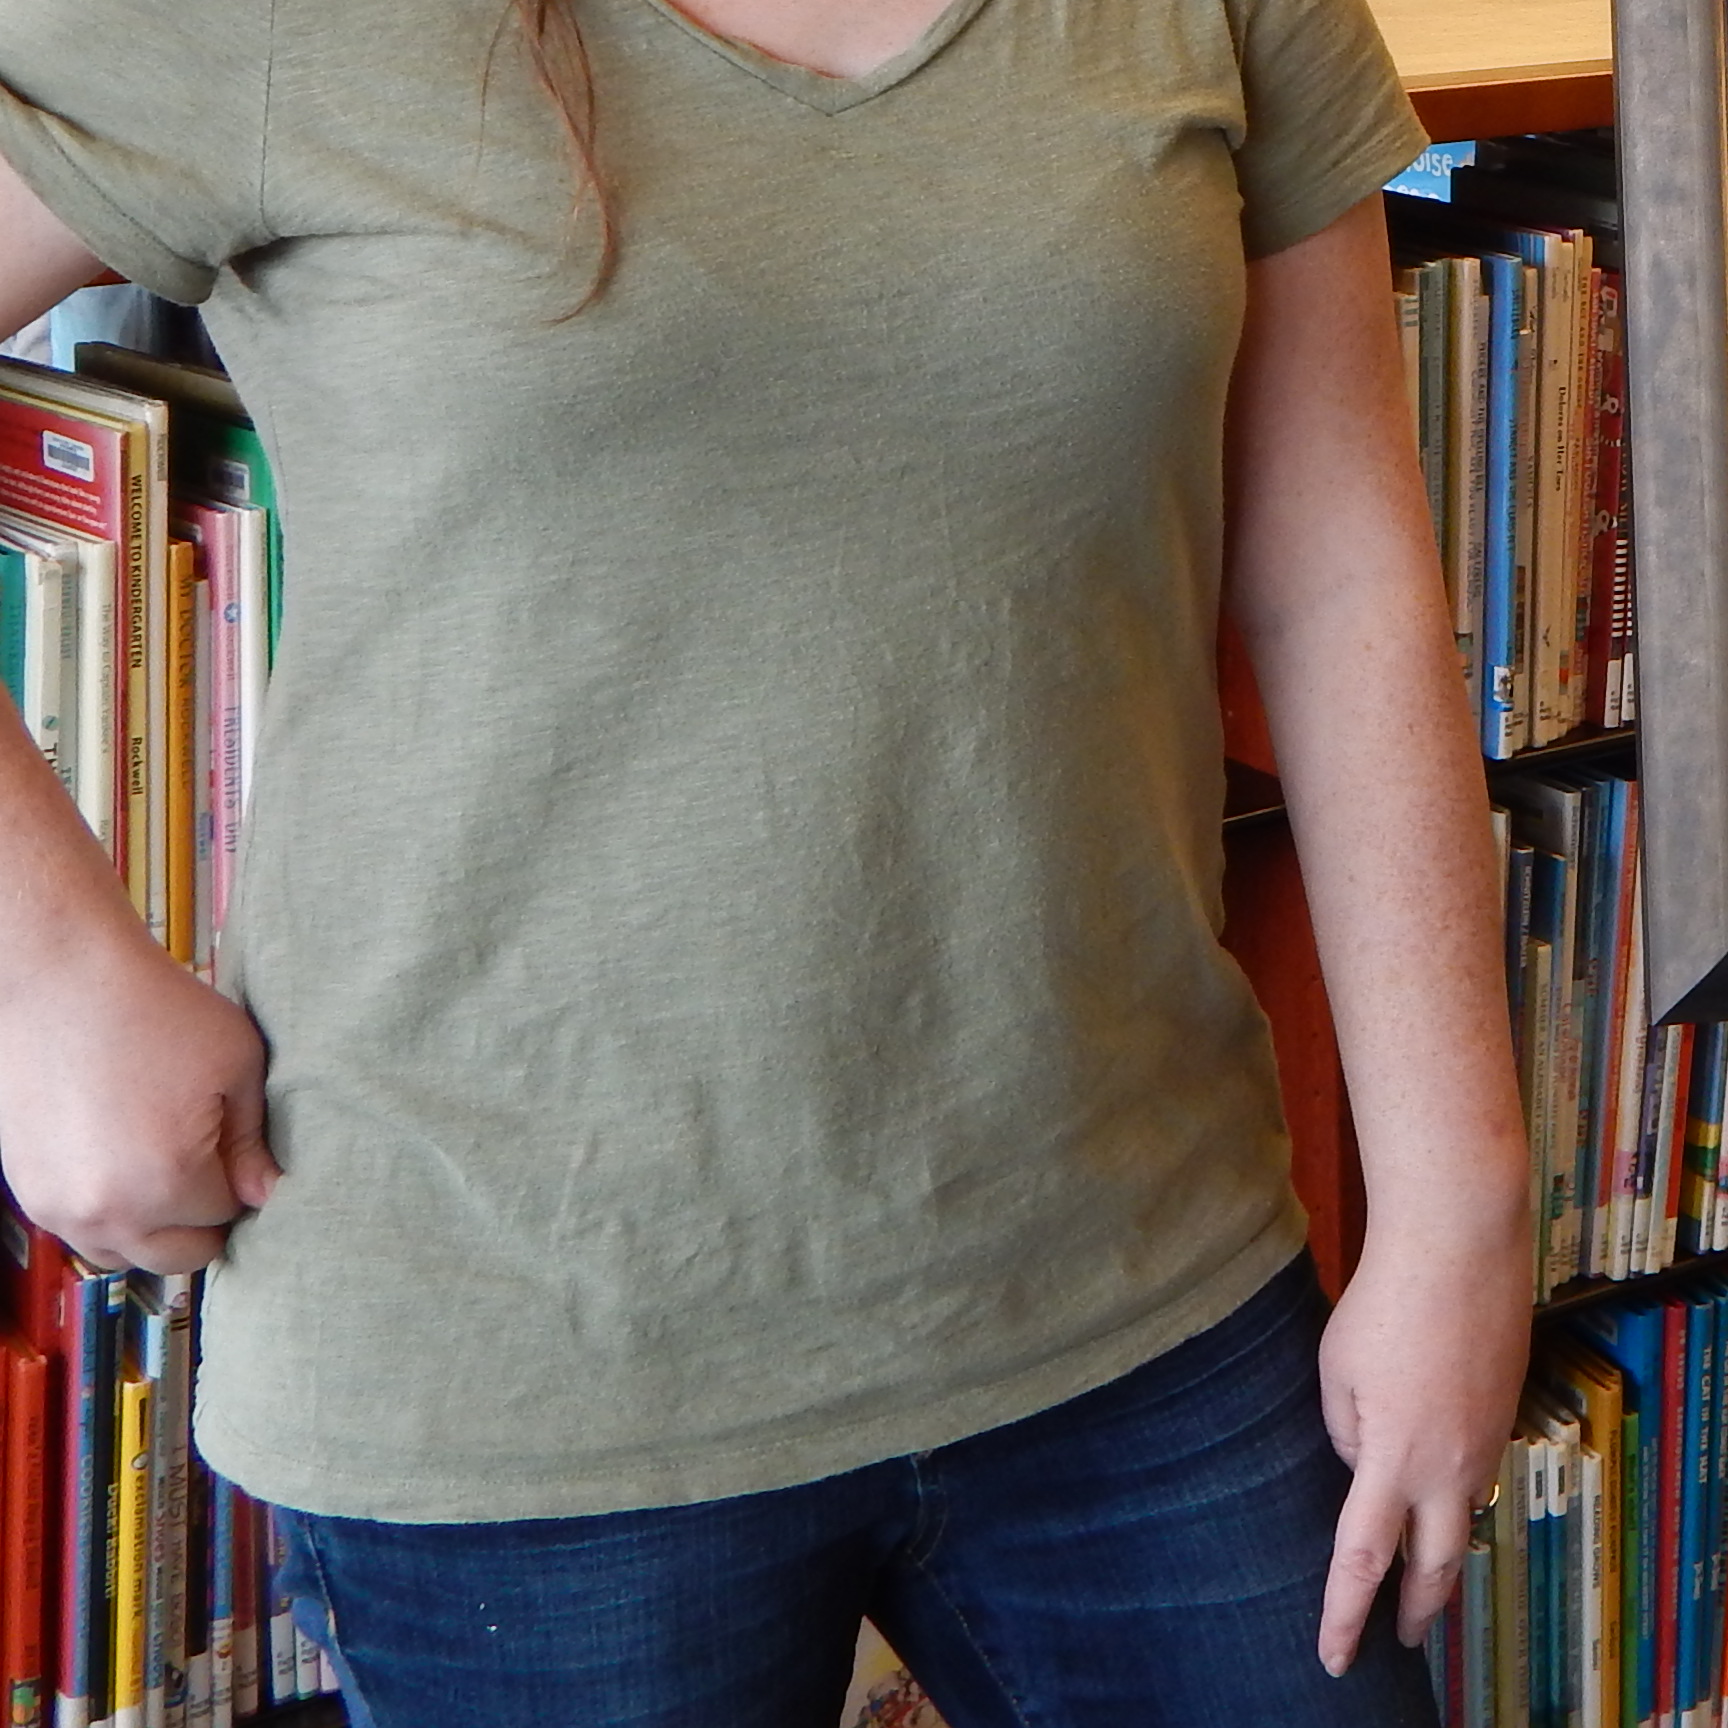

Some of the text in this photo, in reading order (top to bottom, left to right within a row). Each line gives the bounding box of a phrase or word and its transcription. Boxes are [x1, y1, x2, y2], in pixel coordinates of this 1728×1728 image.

[1557, 386, 1567, 427] Dolores
[130, 474, 142, 669] WELCOME TO KINDERGARTEN
[132, 737, 143, 795] Rockwell
[1698, 1347, 1712, 1483] THE CAT IN THE HAT
[134, 1474, 148, 1572] exclamation
[169, 1463, 186, 1529] MUST
[131, 1578, 145, 1619] mark
